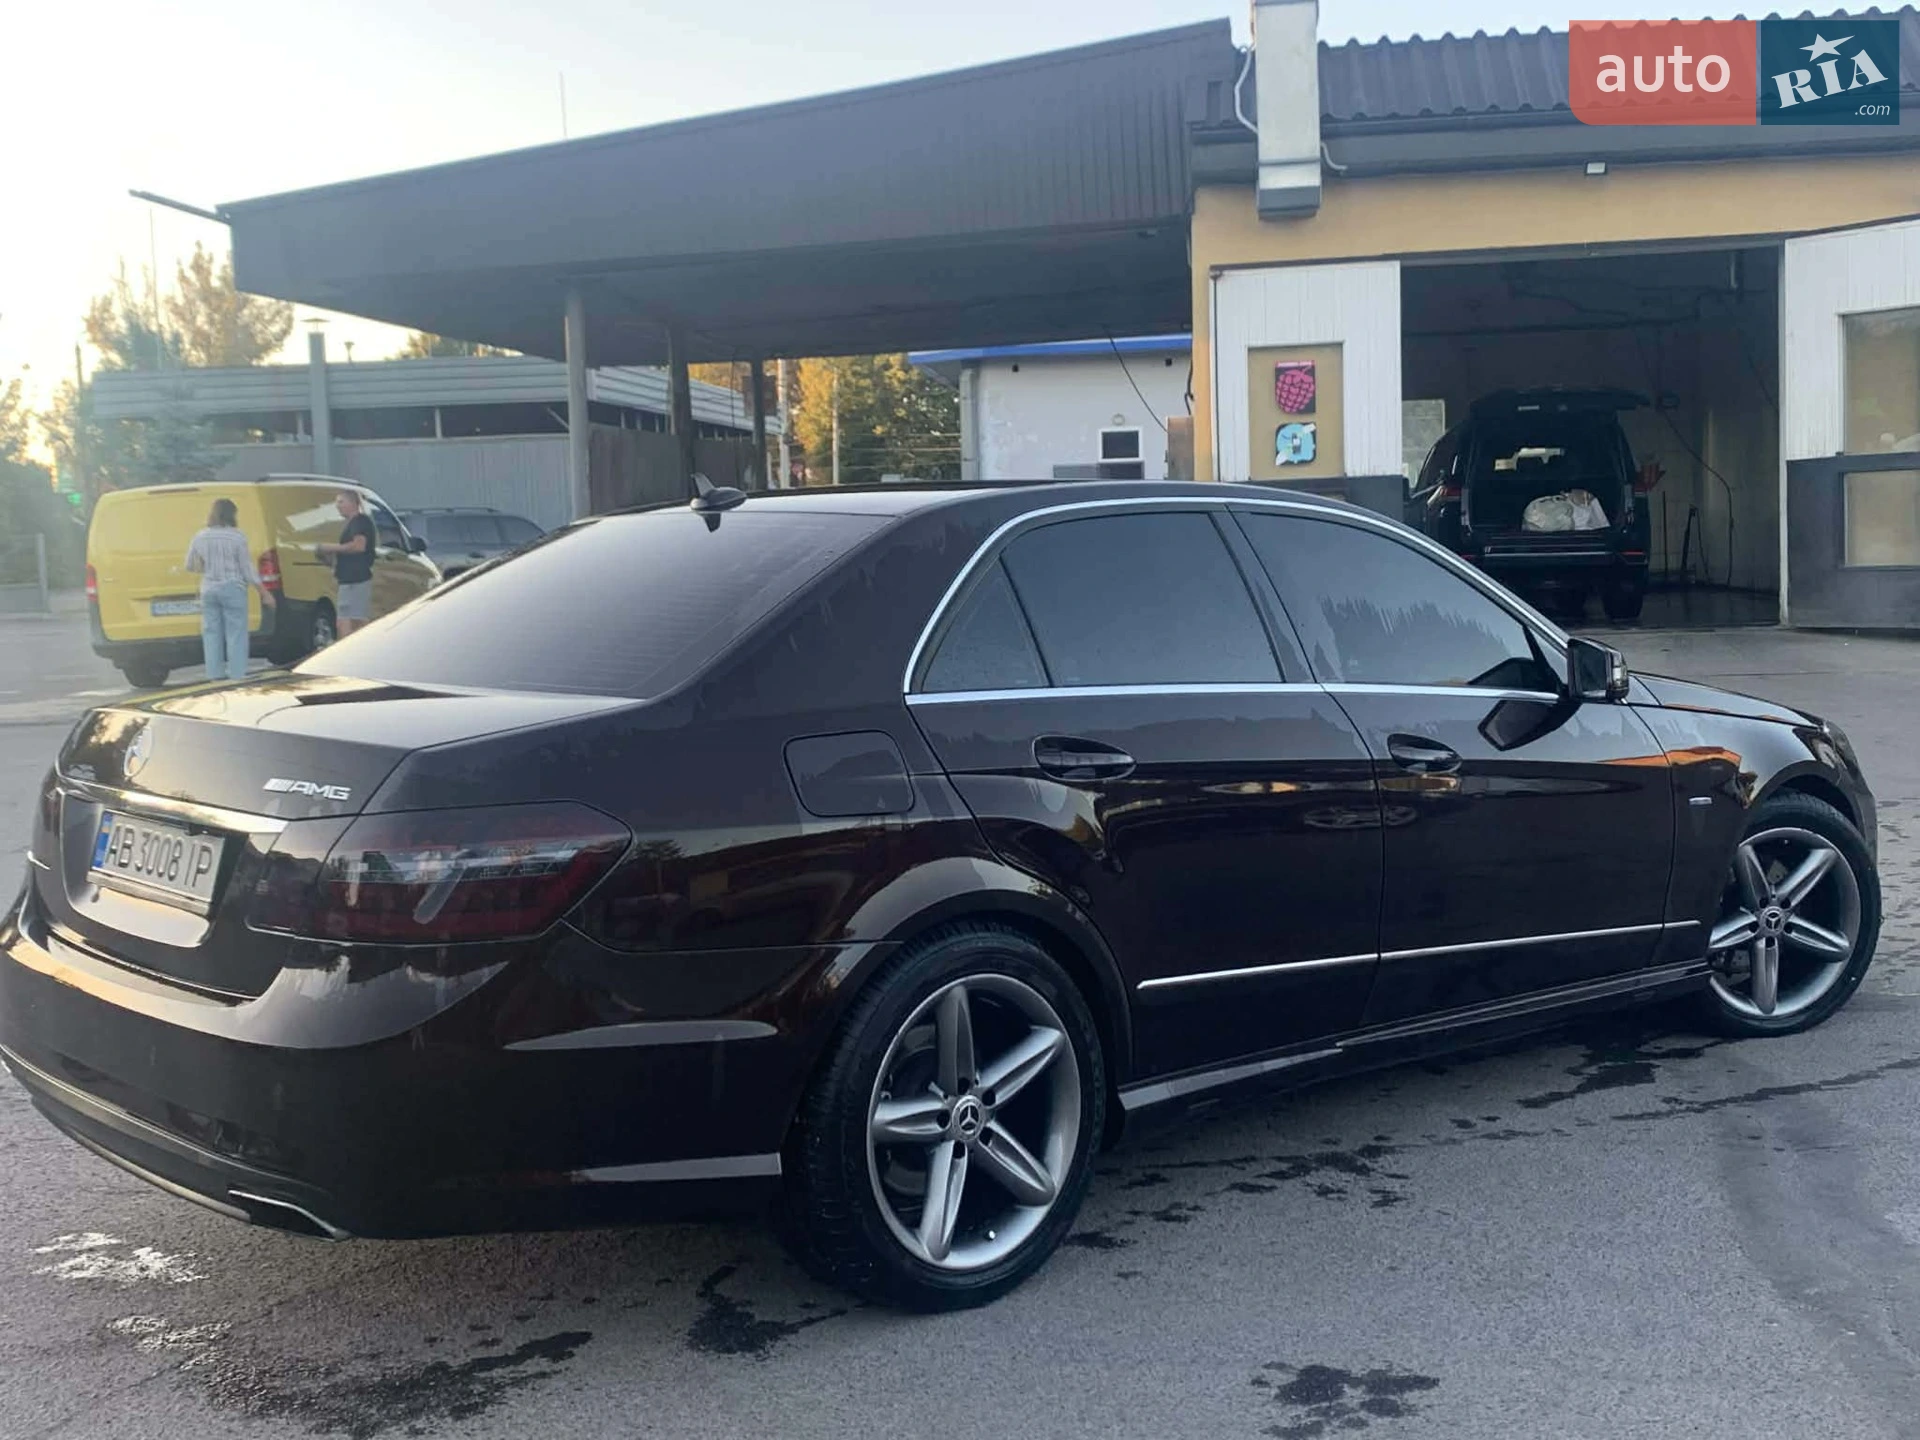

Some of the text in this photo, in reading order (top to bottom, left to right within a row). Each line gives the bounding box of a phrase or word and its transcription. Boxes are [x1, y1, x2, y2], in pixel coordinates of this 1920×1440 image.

[287, 779, 352, 801] AMG
[105, 823, 135, 868] AB
[135, 829, 183, 881] 3008
